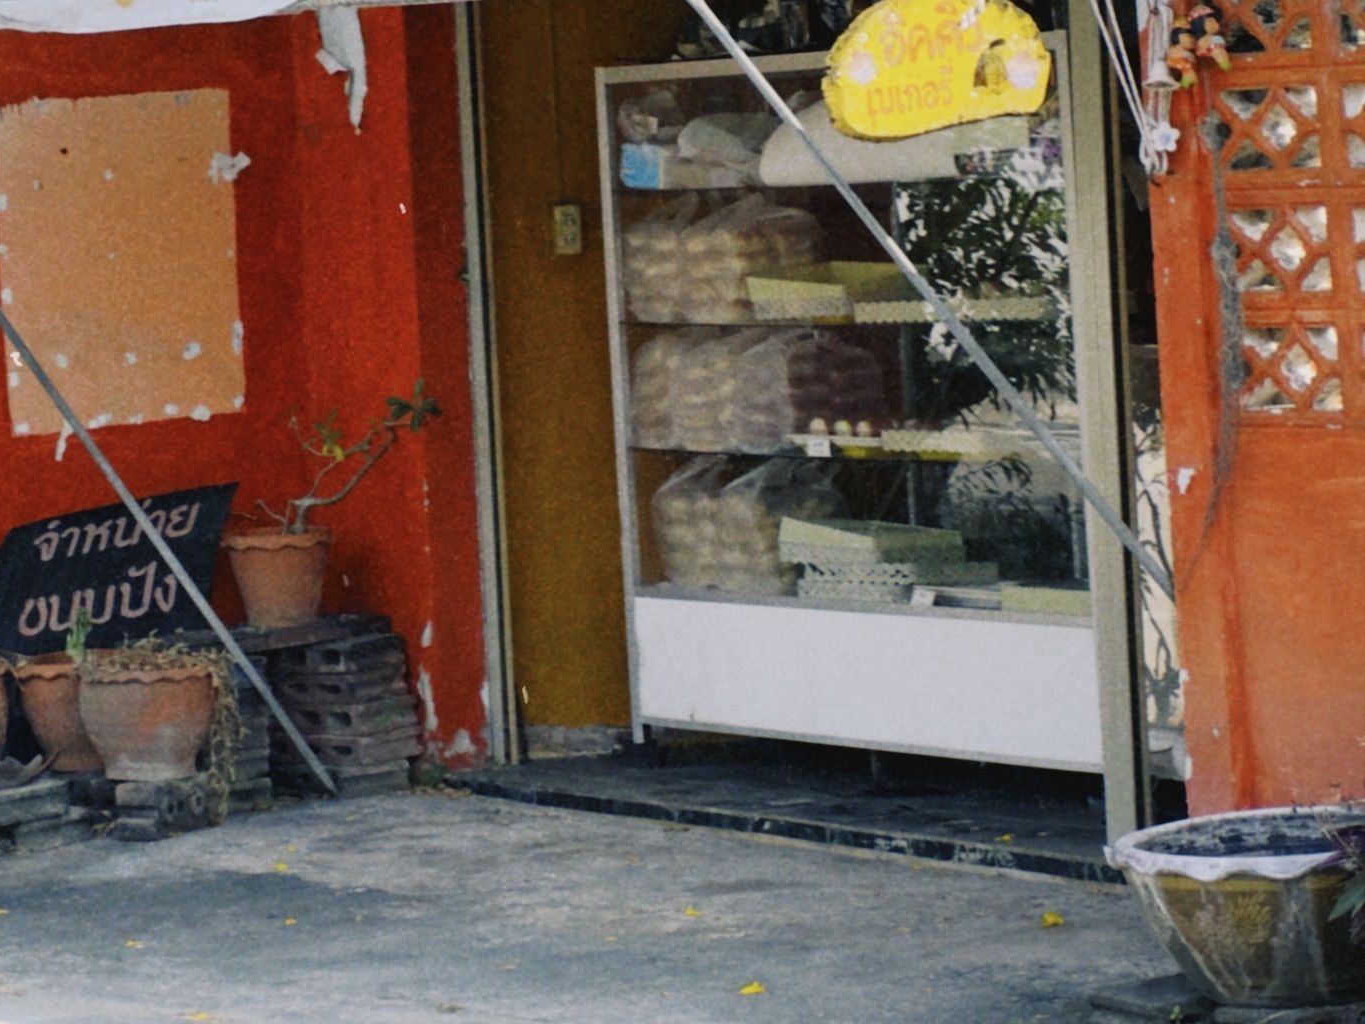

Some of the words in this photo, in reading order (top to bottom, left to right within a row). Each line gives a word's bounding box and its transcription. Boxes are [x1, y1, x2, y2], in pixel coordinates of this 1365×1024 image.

[34, 498, 201, 562] จำหน่าย
[18, 560, 177, 637] ขนมปัง
